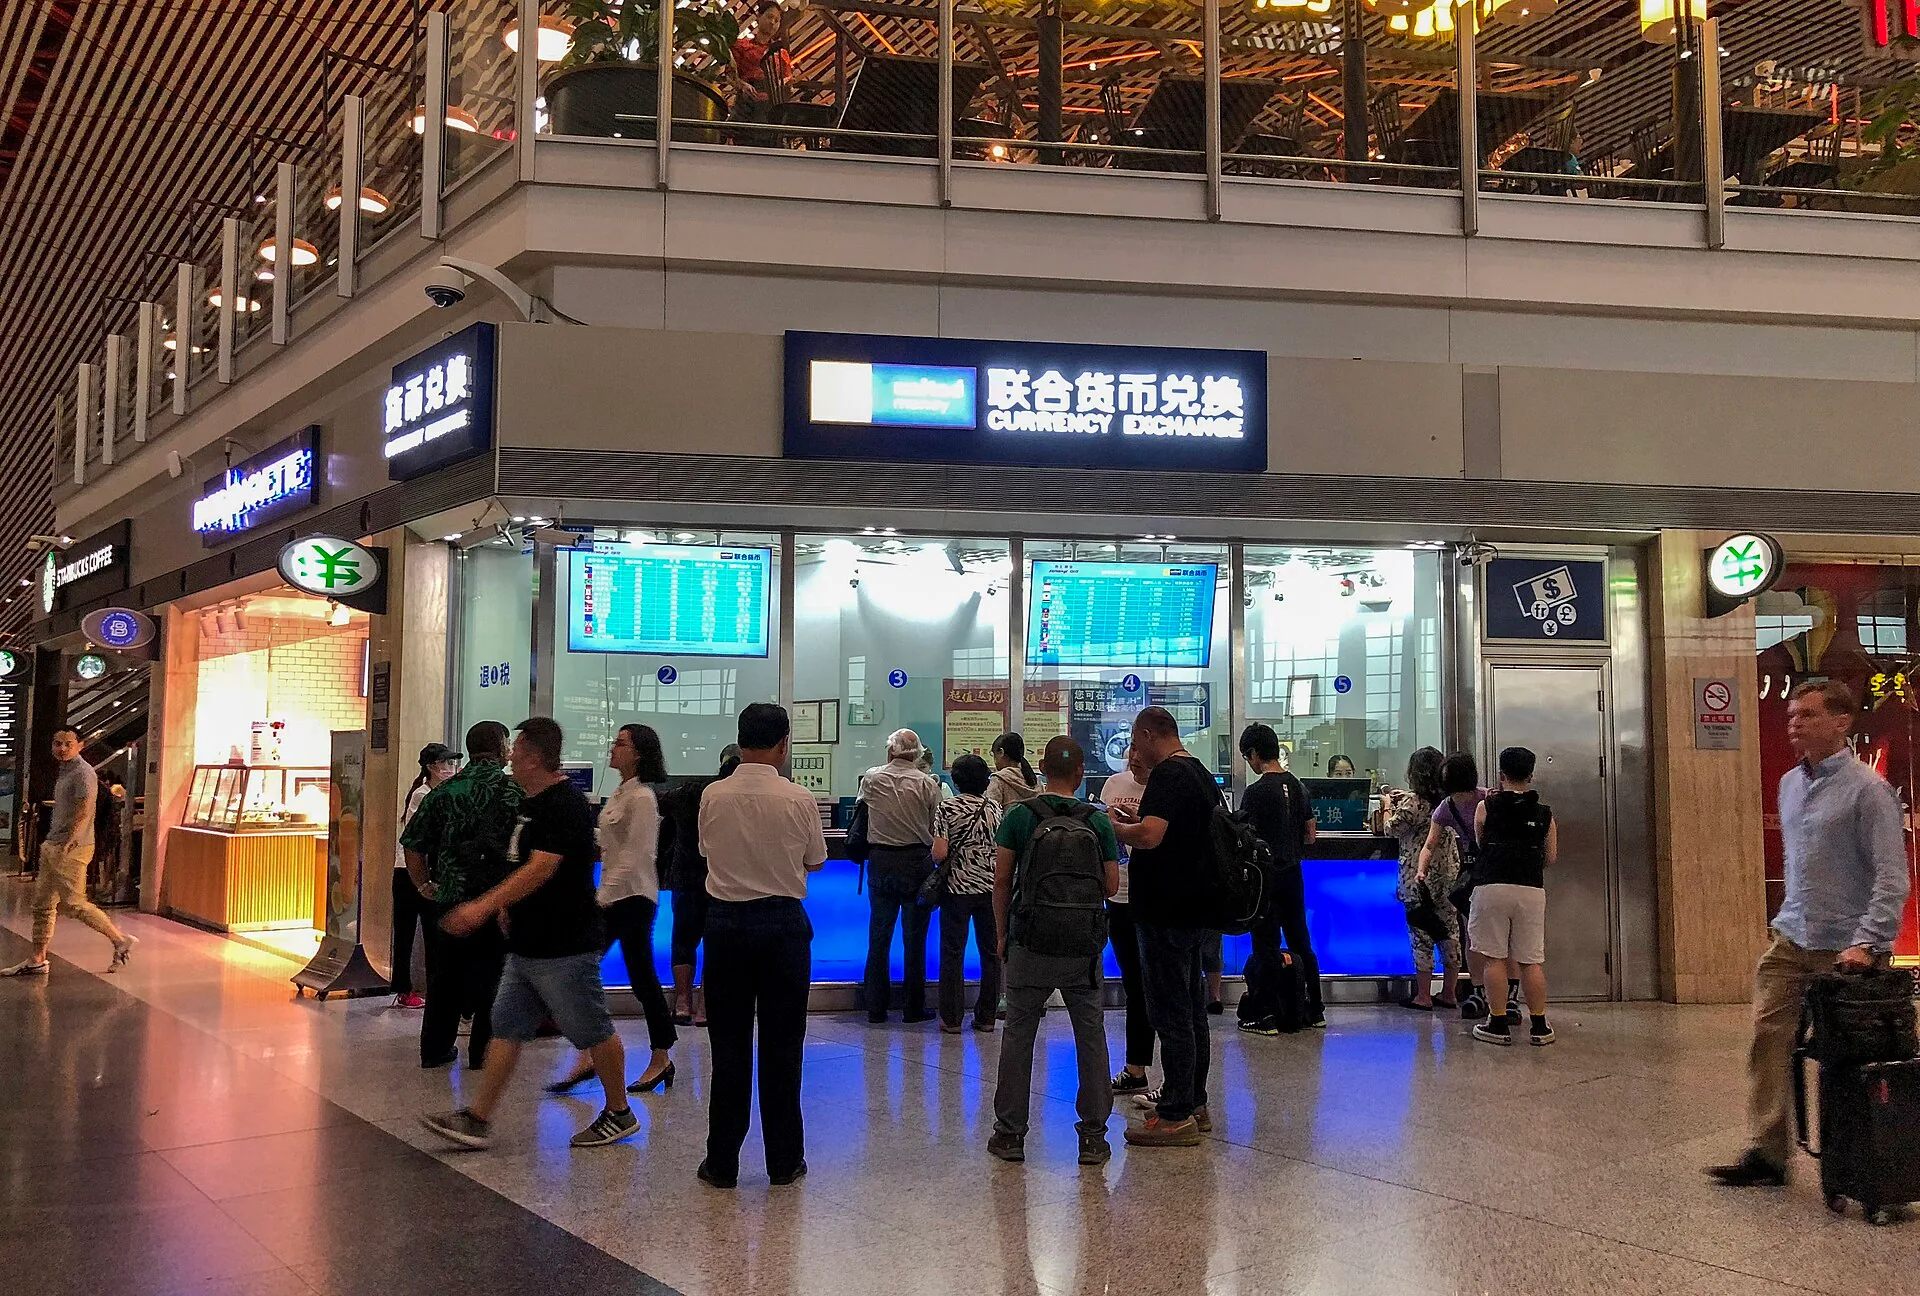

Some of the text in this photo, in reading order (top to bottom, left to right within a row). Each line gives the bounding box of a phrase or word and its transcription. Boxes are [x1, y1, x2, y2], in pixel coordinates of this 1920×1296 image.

[987, 368, 1244, 417] 联合货币兑换
[987, 410, 1244, 438] CURRENCY EXCHANGE
[56, 544, 113, 588] STARBUCKS COFFEE
[1074, 689, 1116, 700] 您可在此
[1074, 700, 1117, 712] 领取退税
